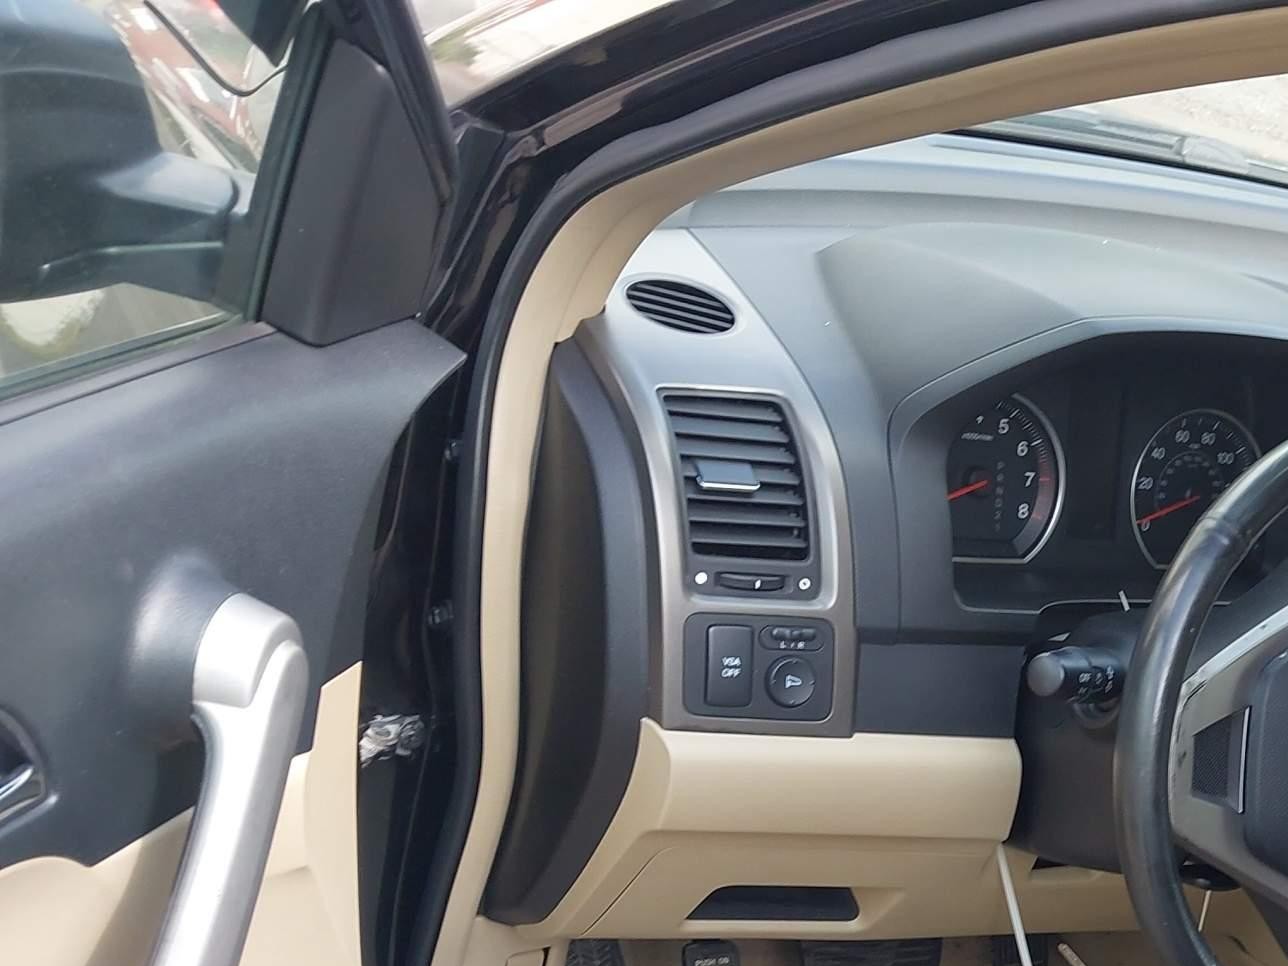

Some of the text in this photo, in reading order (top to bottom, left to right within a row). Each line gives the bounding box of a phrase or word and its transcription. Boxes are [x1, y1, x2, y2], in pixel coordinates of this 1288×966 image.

[998, 418, 1010, 434] 5
[1175, 430, 1191, 443] 60
[1201, 432, 1216, 446] 80
[1016, 440, 1029, 457] 6
[1151, 447, 1166, 460] 40
[1216, 451, 1235, 465] 100
[1023, 471, 1036, 488] 7
[1137, 476, 1154, 490] 20
[1017, 502, 1030, 519] 8
[721, 656, 741, 667] VSA
[720, 667, 742, 678] OFF
